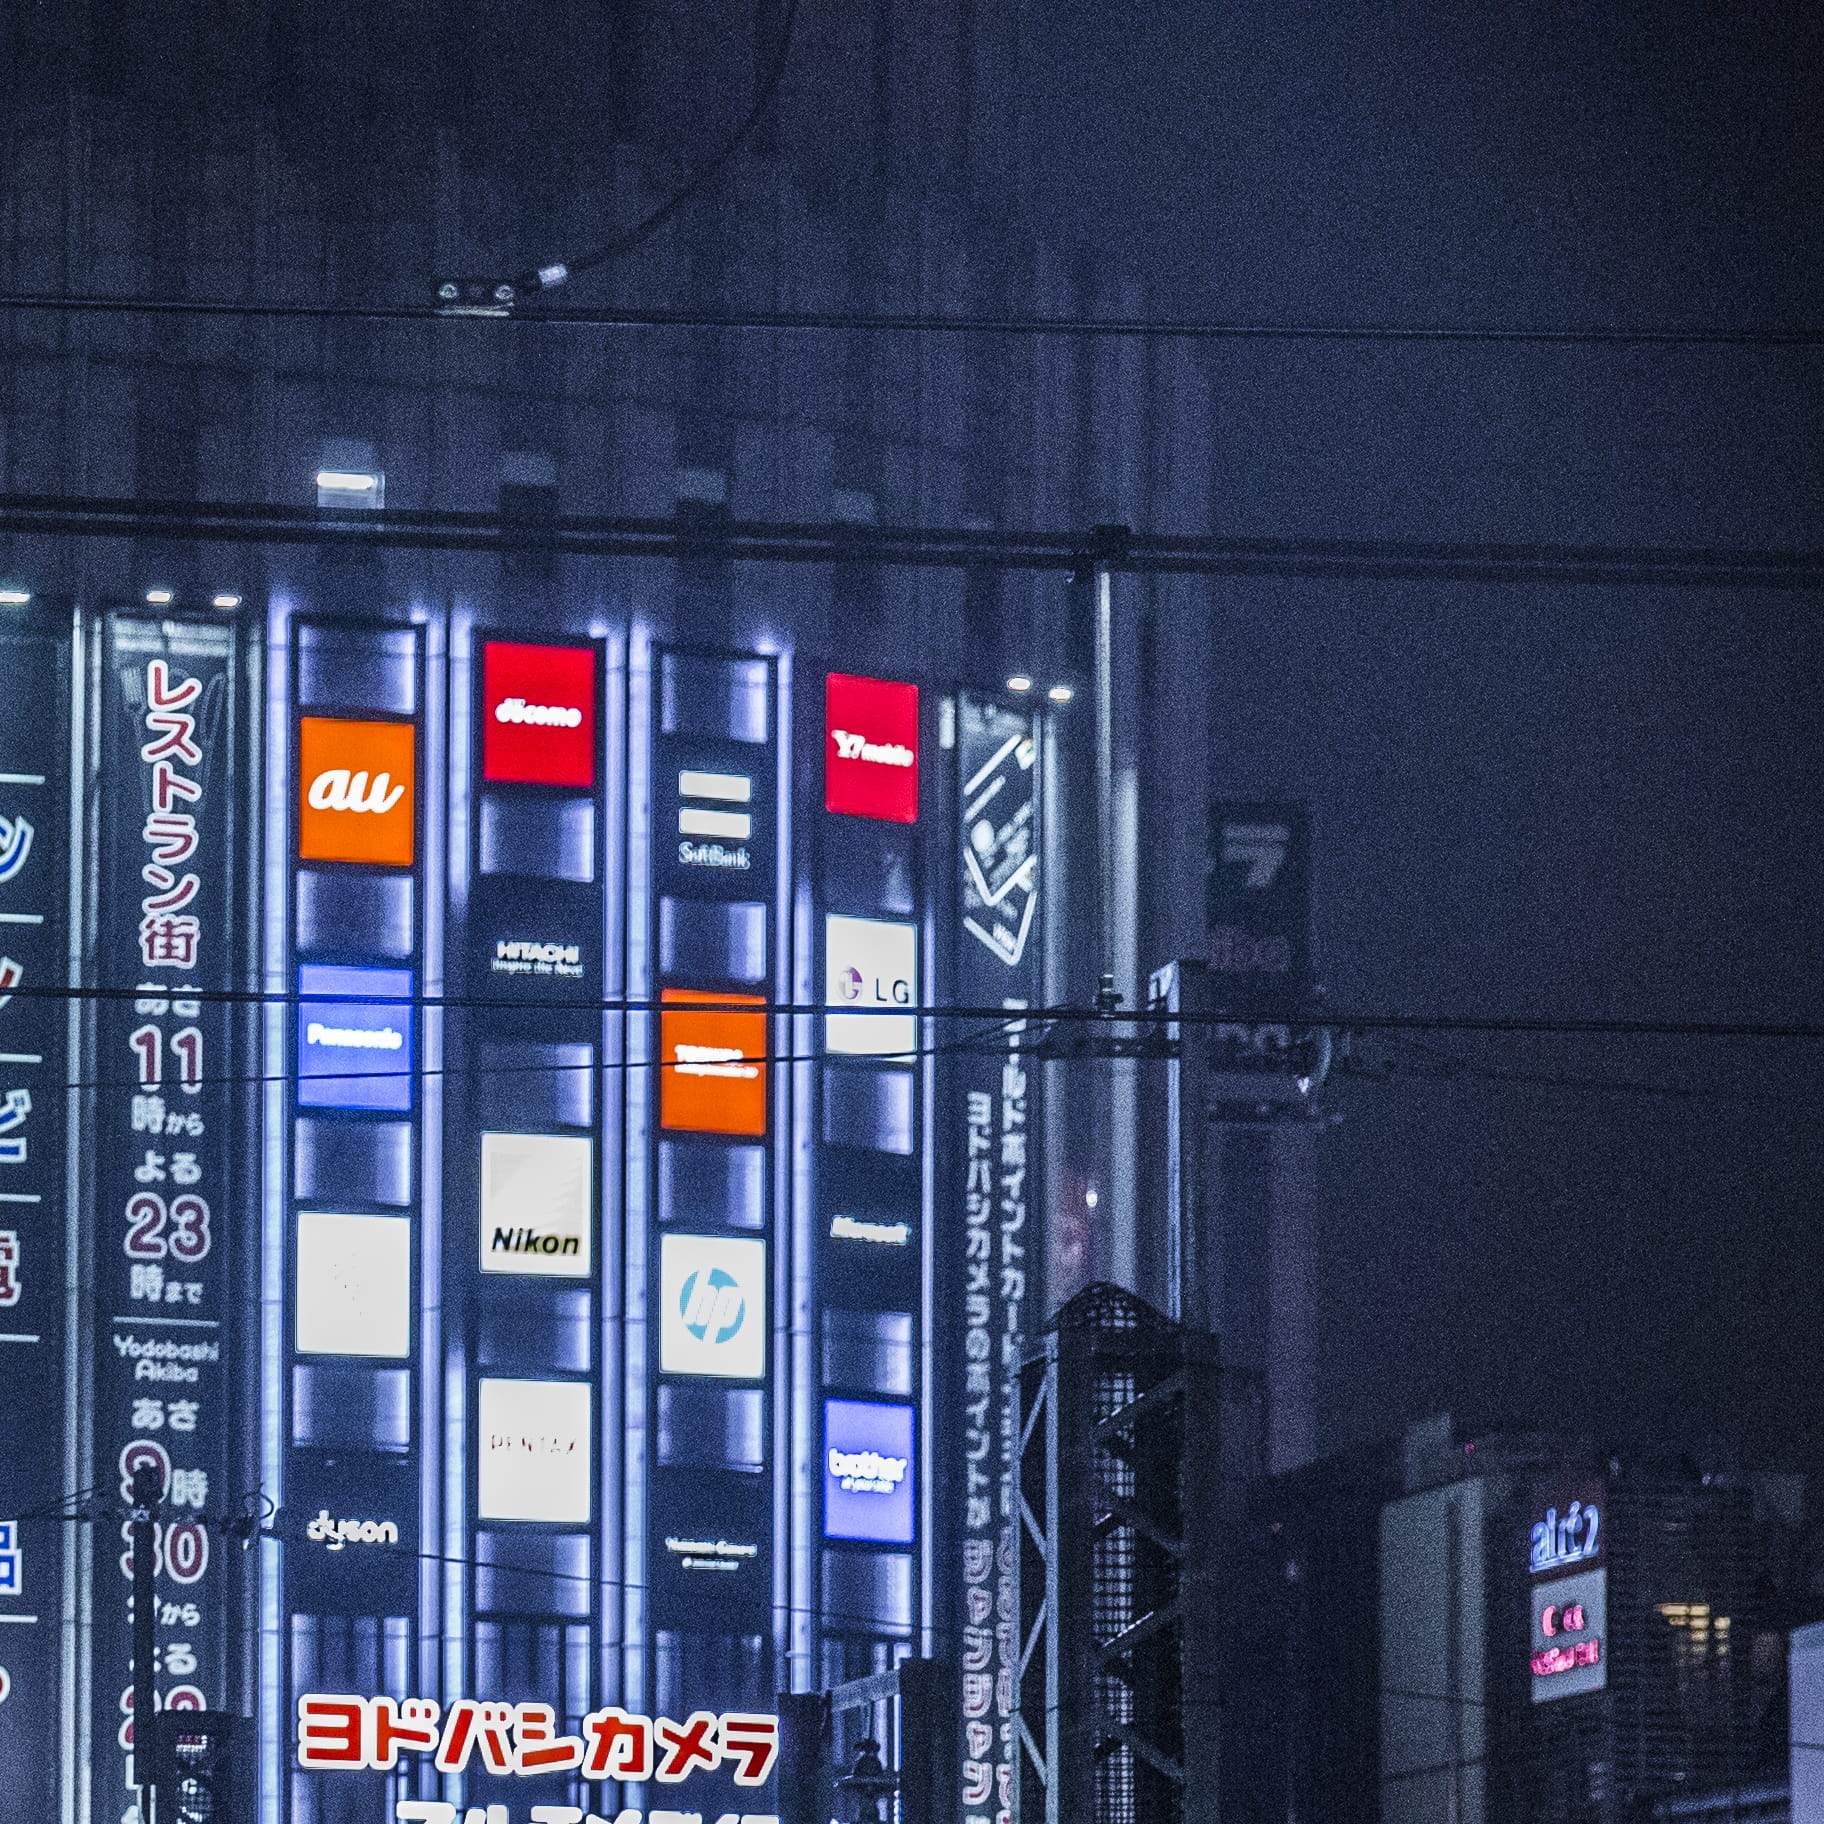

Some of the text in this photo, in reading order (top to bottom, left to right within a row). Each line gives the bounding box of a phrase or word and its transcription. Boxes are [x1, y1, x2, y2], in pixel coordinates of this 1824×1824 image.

[308, 768, 404, 814] au
[140, 659, 202, 969] レストラン街
[678, 840, 751, 870] SoftBank
[497, 940, 579, 963] HITACHI
[874, 976, 910, 1004] LG
[130, 1024, 204, 1093] 11
[134, 1150, 202, 1185] よる
[123, 1192, 211, 1263] 23
[491, 1227, 580, 1256] Nikon
[112, 1335, 220, 1364] Yodobashi
[133, 1357, 199, 1384] Akiba
[131, 1398, 200, 1431] あさ
[306, 1510, 399, 1551] dyson
[298, 1693, 779, 1785] ヨドバシカメラ
